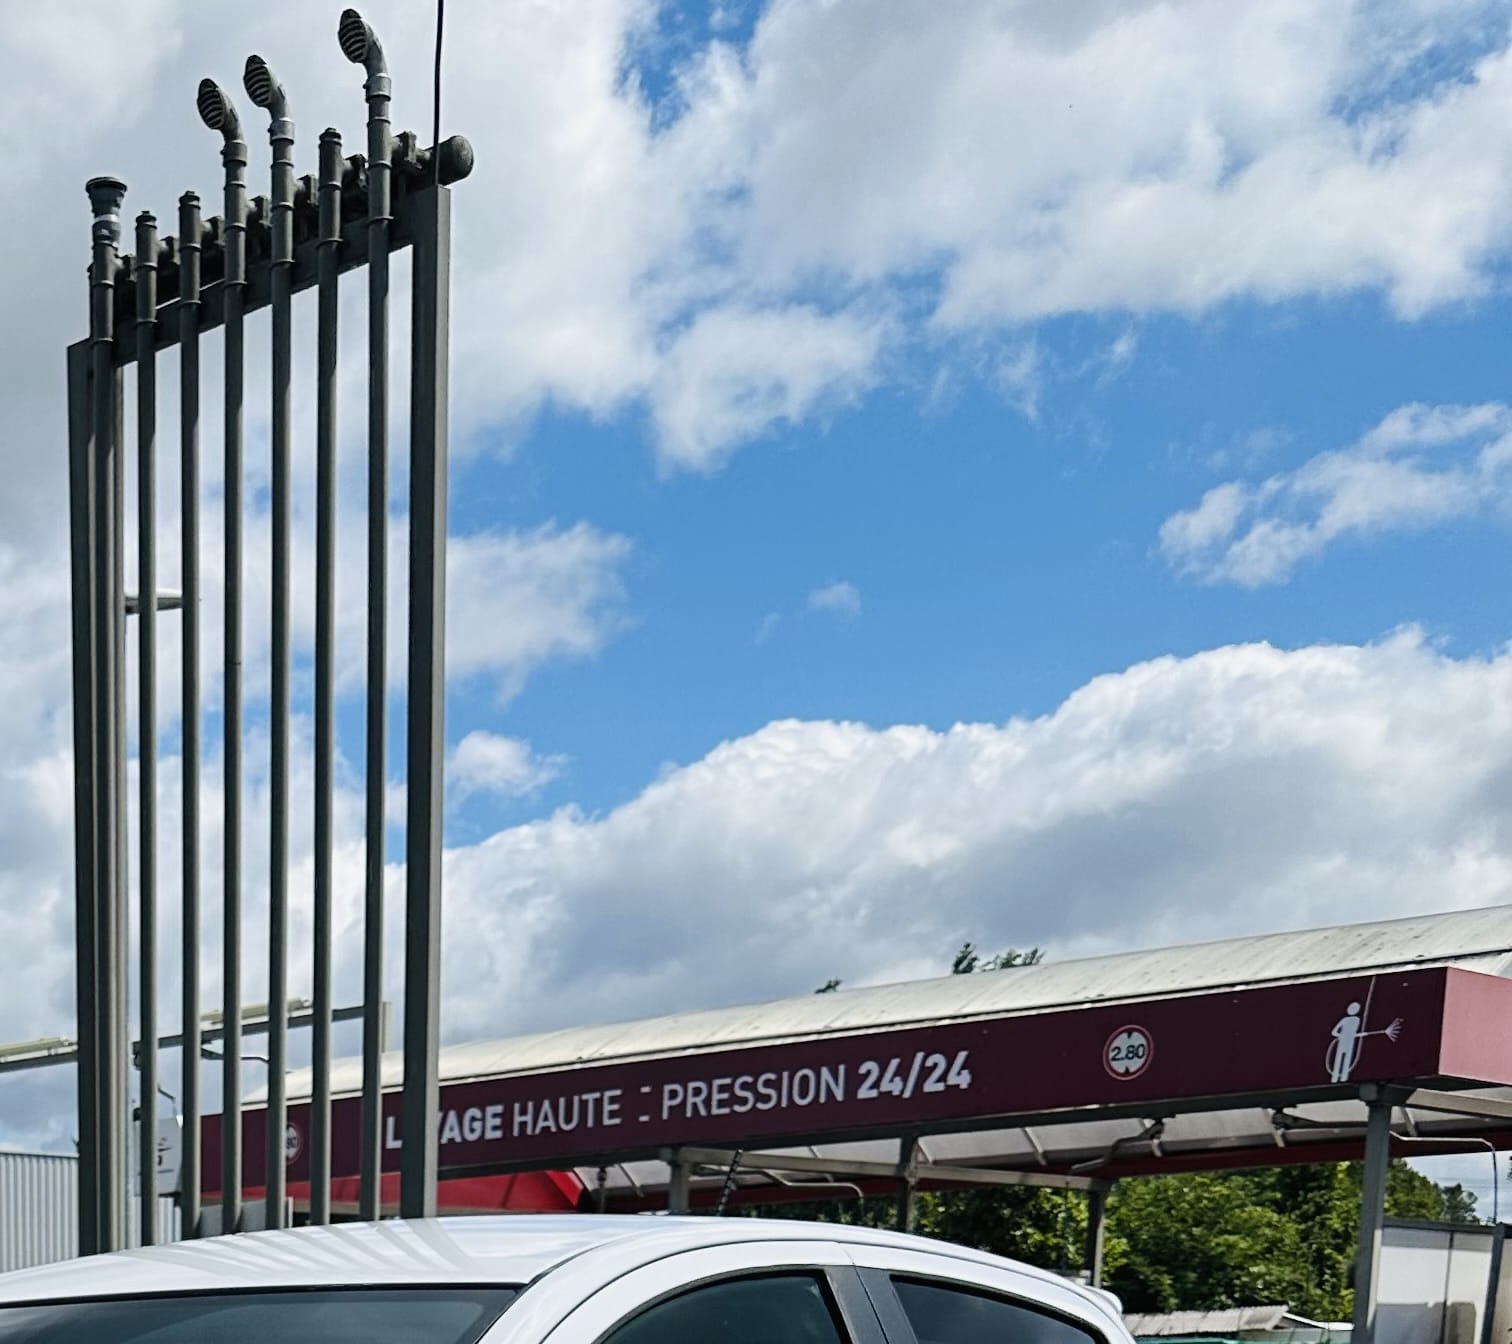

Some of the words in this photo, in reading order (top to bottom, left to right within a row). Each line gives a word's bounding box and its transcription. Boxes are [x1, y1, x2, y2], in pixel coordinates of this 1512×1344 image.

[1110, 1043, 1146, 1062] 2.80
[385, 1104, 505, 1150] LAGE
[512, 1089, 623, 1137] HAUTE
[661, 1063, 847, 1121] PRESSION
[856, 1050, 973, 1100] 24/24
